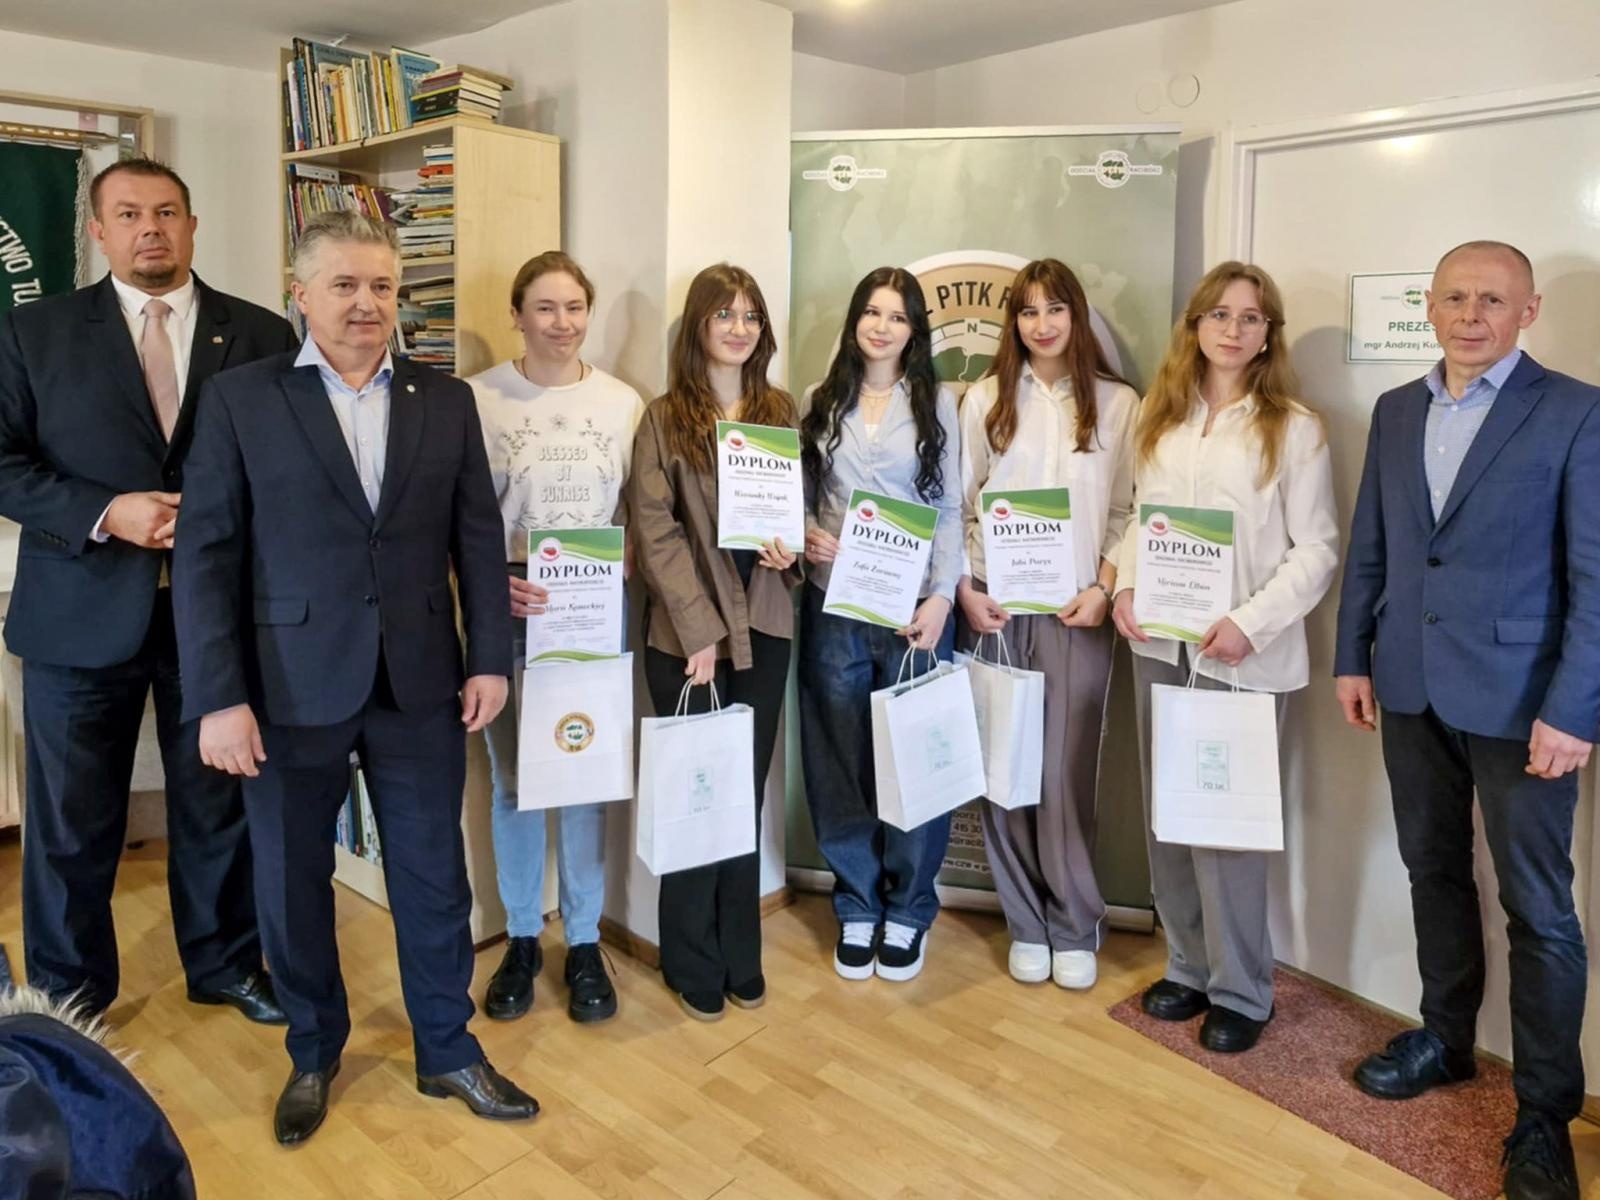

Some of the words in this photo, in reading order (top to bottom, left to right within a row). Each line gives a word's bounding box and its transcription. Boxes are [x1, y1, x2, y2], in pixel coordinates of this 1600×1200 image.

[11, 278, 43, 307] TU
[936, 281, 993, 310] PTTK
[967, 323, 978, 333] N
[1364, 342, 1381, 350] mgr
[1384, 341, 1420, 350] Andrzej
[728, 454, 792, 472] DYPLOM
[852, 523, 920, 551] DYPLOM
[993, 522, 1062, 536] DYPLOM
[1148, 539, 1222, 558] DYPLOM
[539, 564, 612, 579] DYPLOM
